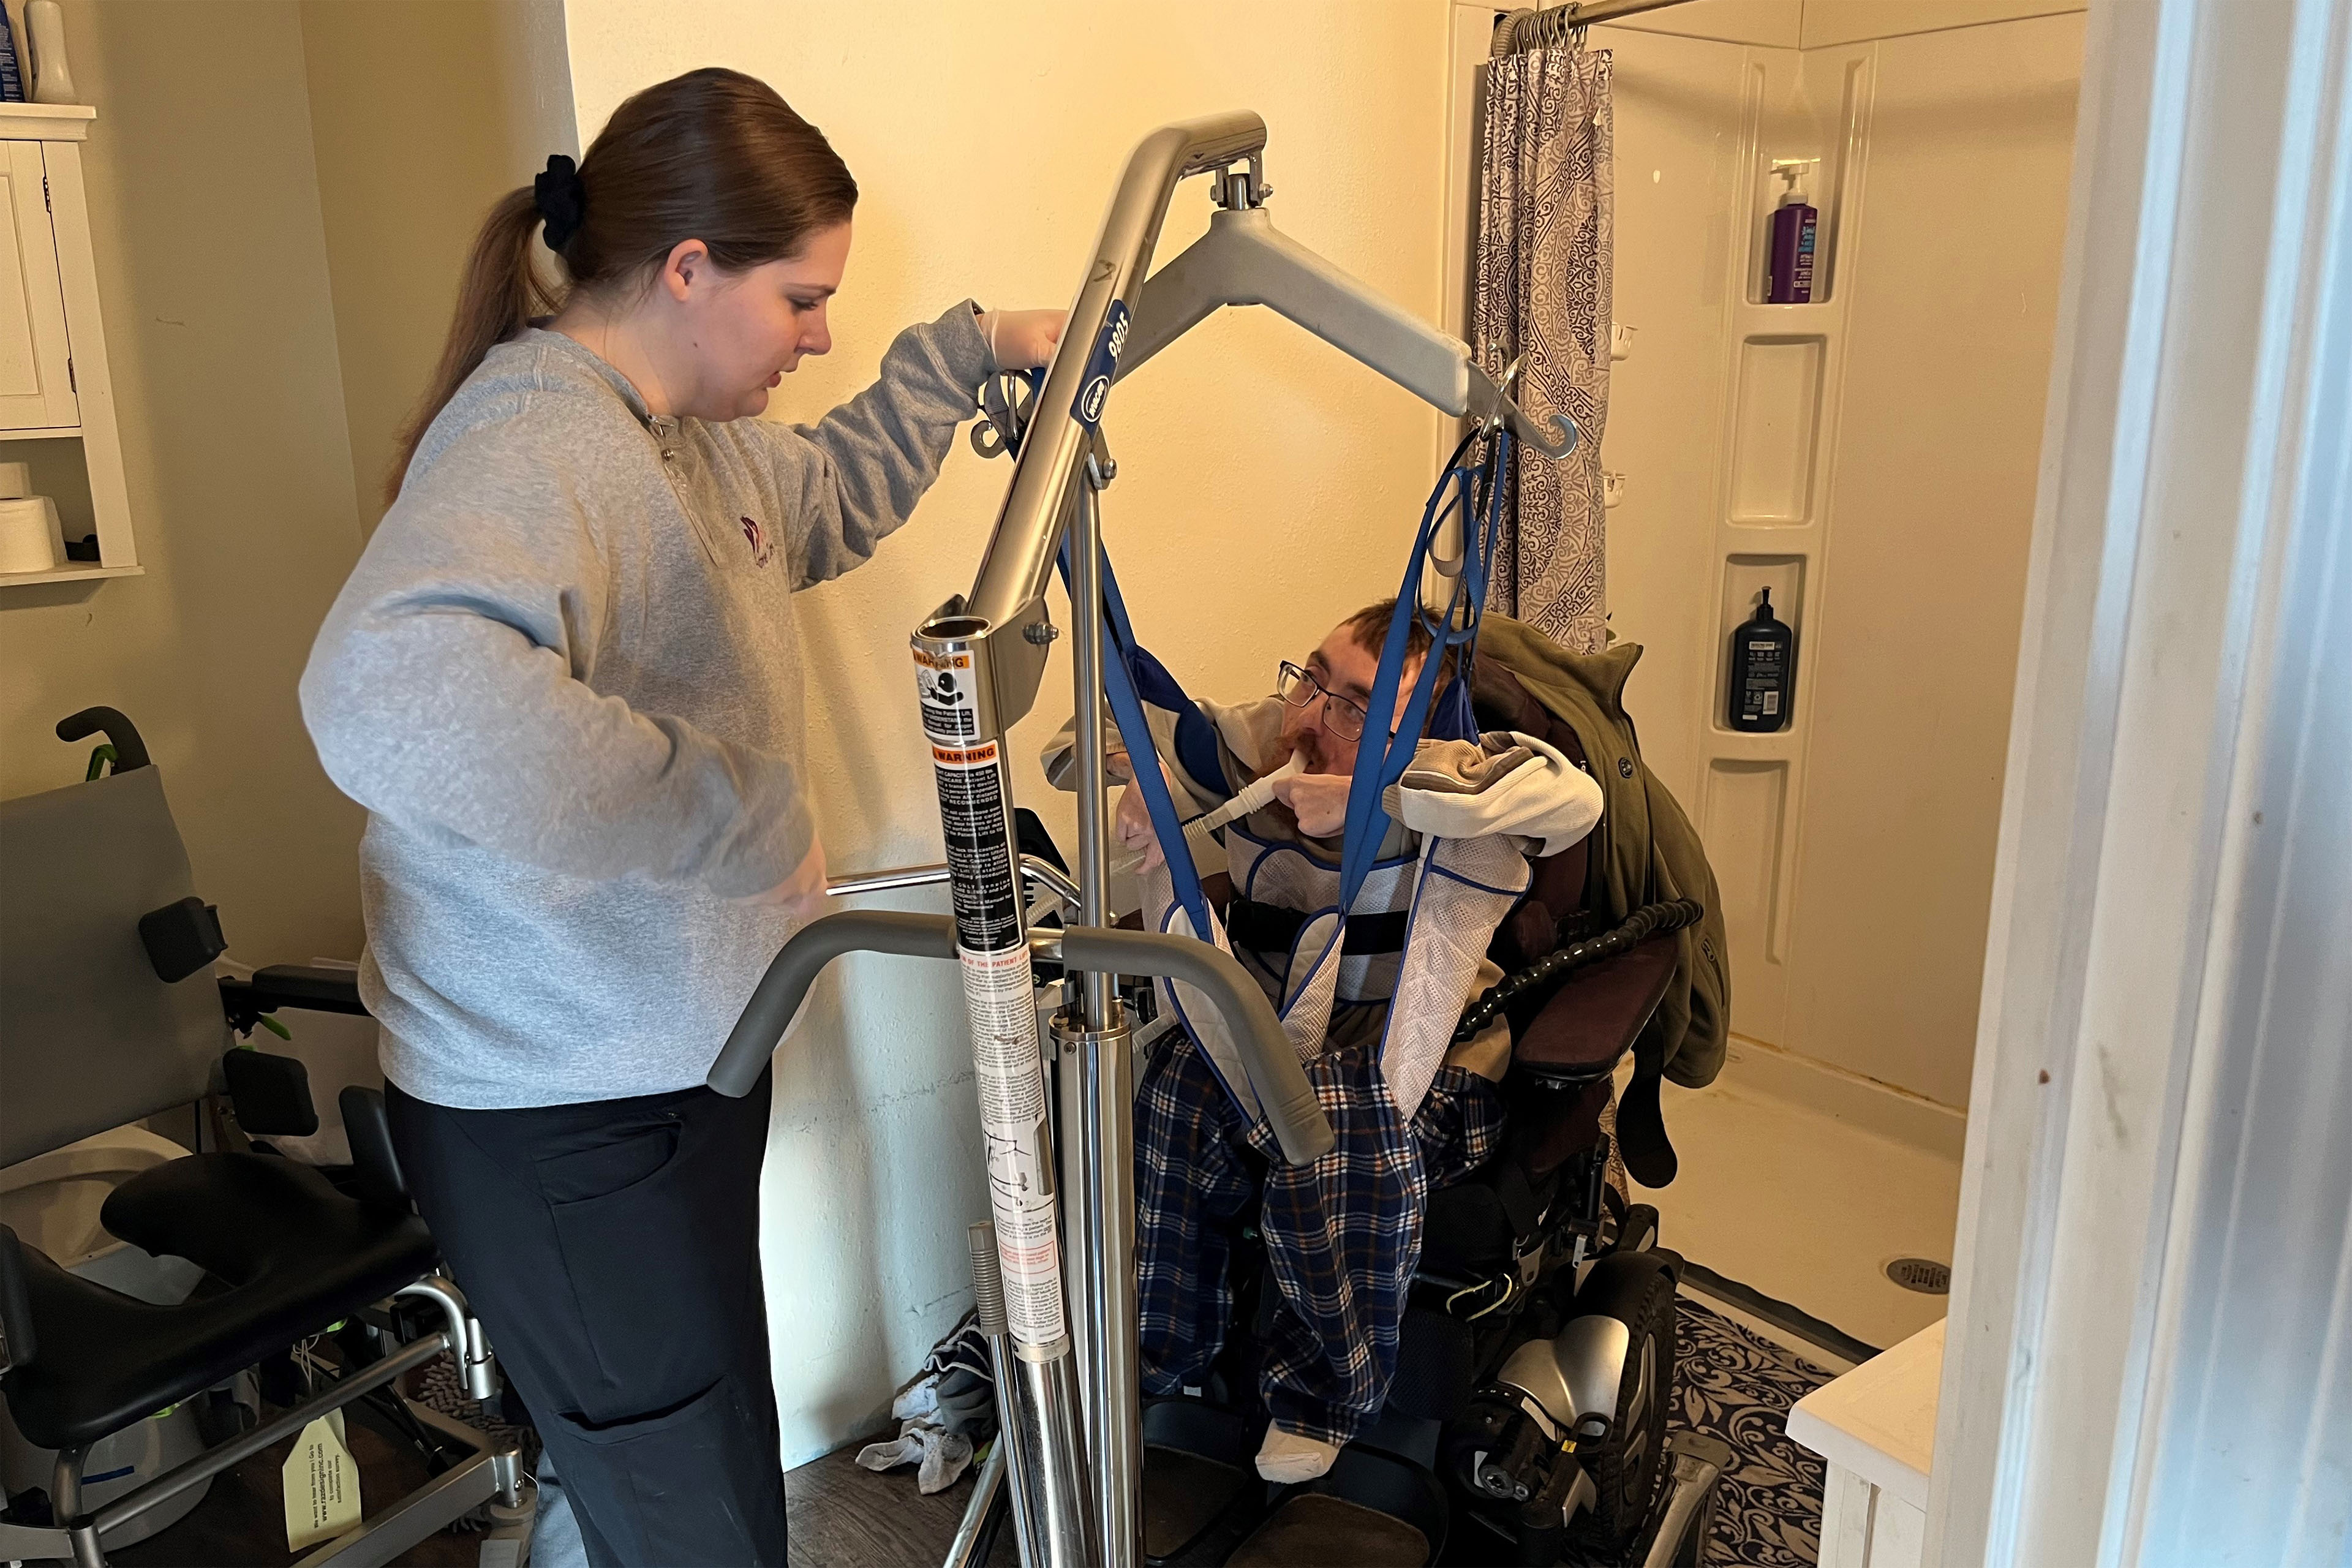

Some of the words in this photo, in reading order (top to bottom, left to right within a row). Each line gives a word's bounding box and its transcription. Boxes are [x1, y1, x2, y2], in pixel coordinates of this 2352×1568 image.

[1108, 311, 1129, 364] 9805
[938, 748, 994, 761] WARNING
[949, 795, 998, 805] RECOMMENDED
[992, 957, 1017, 967] PATIENT
[317, 1443, 327, 1521] www.razdesigninc.com
